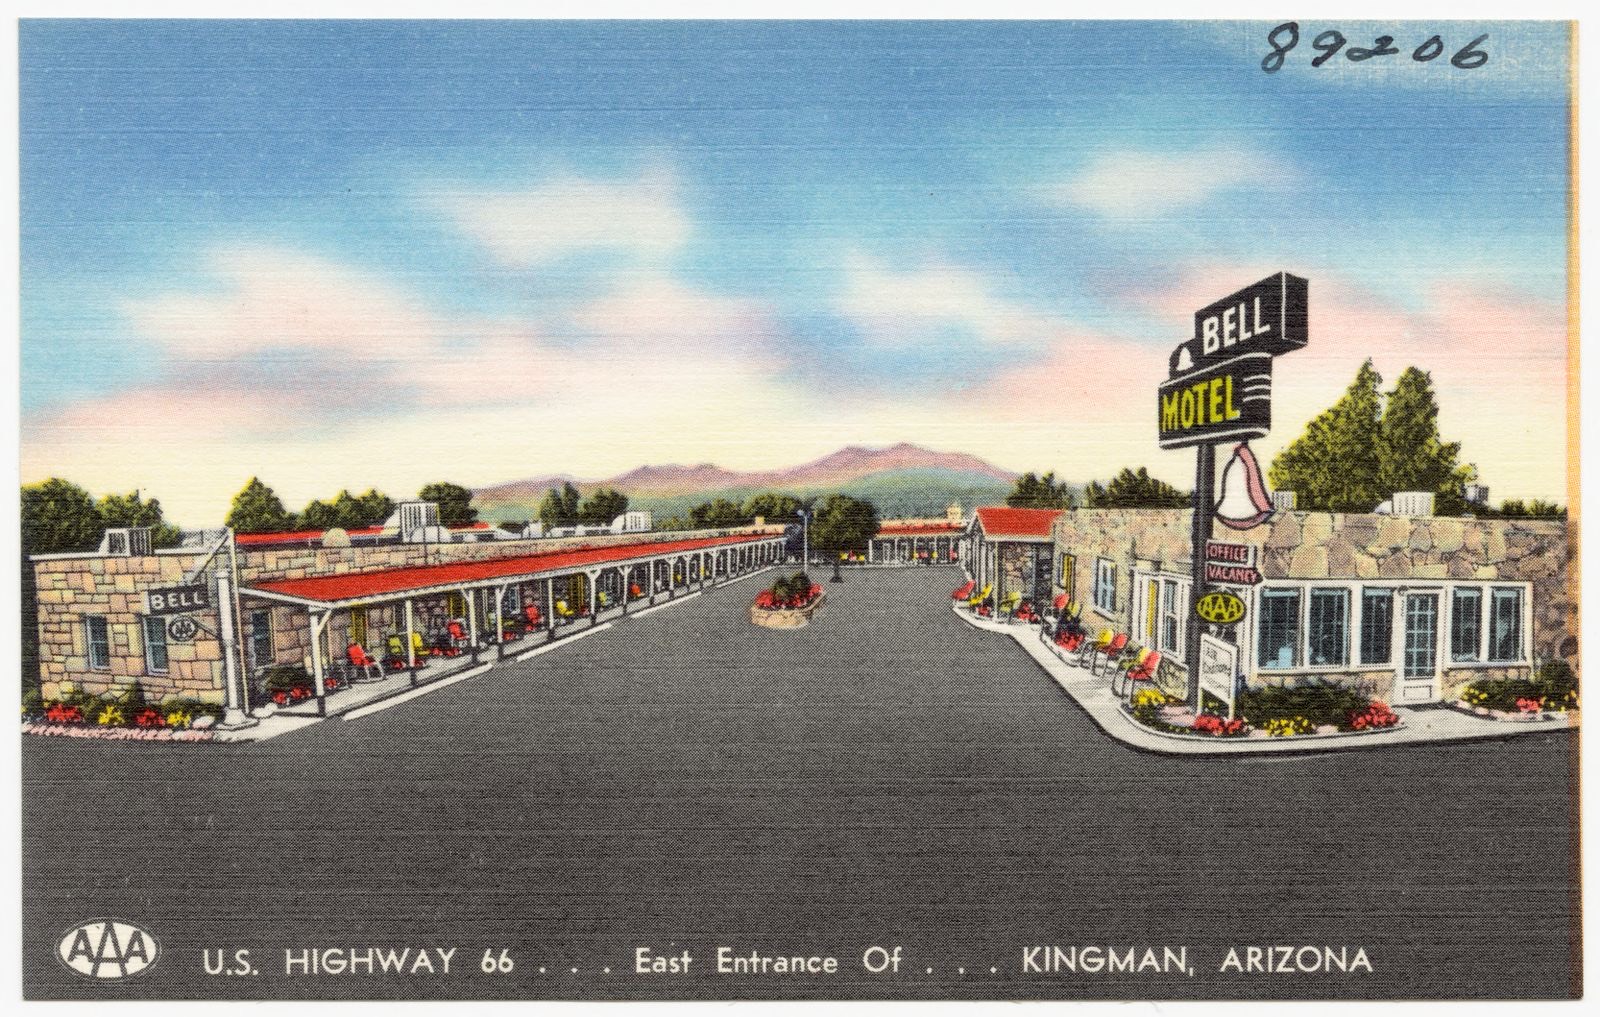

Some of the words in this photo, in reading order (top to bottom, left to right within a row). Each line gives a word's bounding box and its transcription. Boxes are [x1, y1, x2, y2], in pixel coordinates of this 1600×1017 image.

[1261, 21, 1488, 73] 89206
[1203, 297, 1271, 355] BELL
[1163, 375, 1241, 432] MOTEL
[1209, 545, 1247, 560] OFFICE
[1208, 565, 1257, 582] VACANCY
[150, 592, 204, 609] BELL
[1200, 594, 1242, 620] AAA
